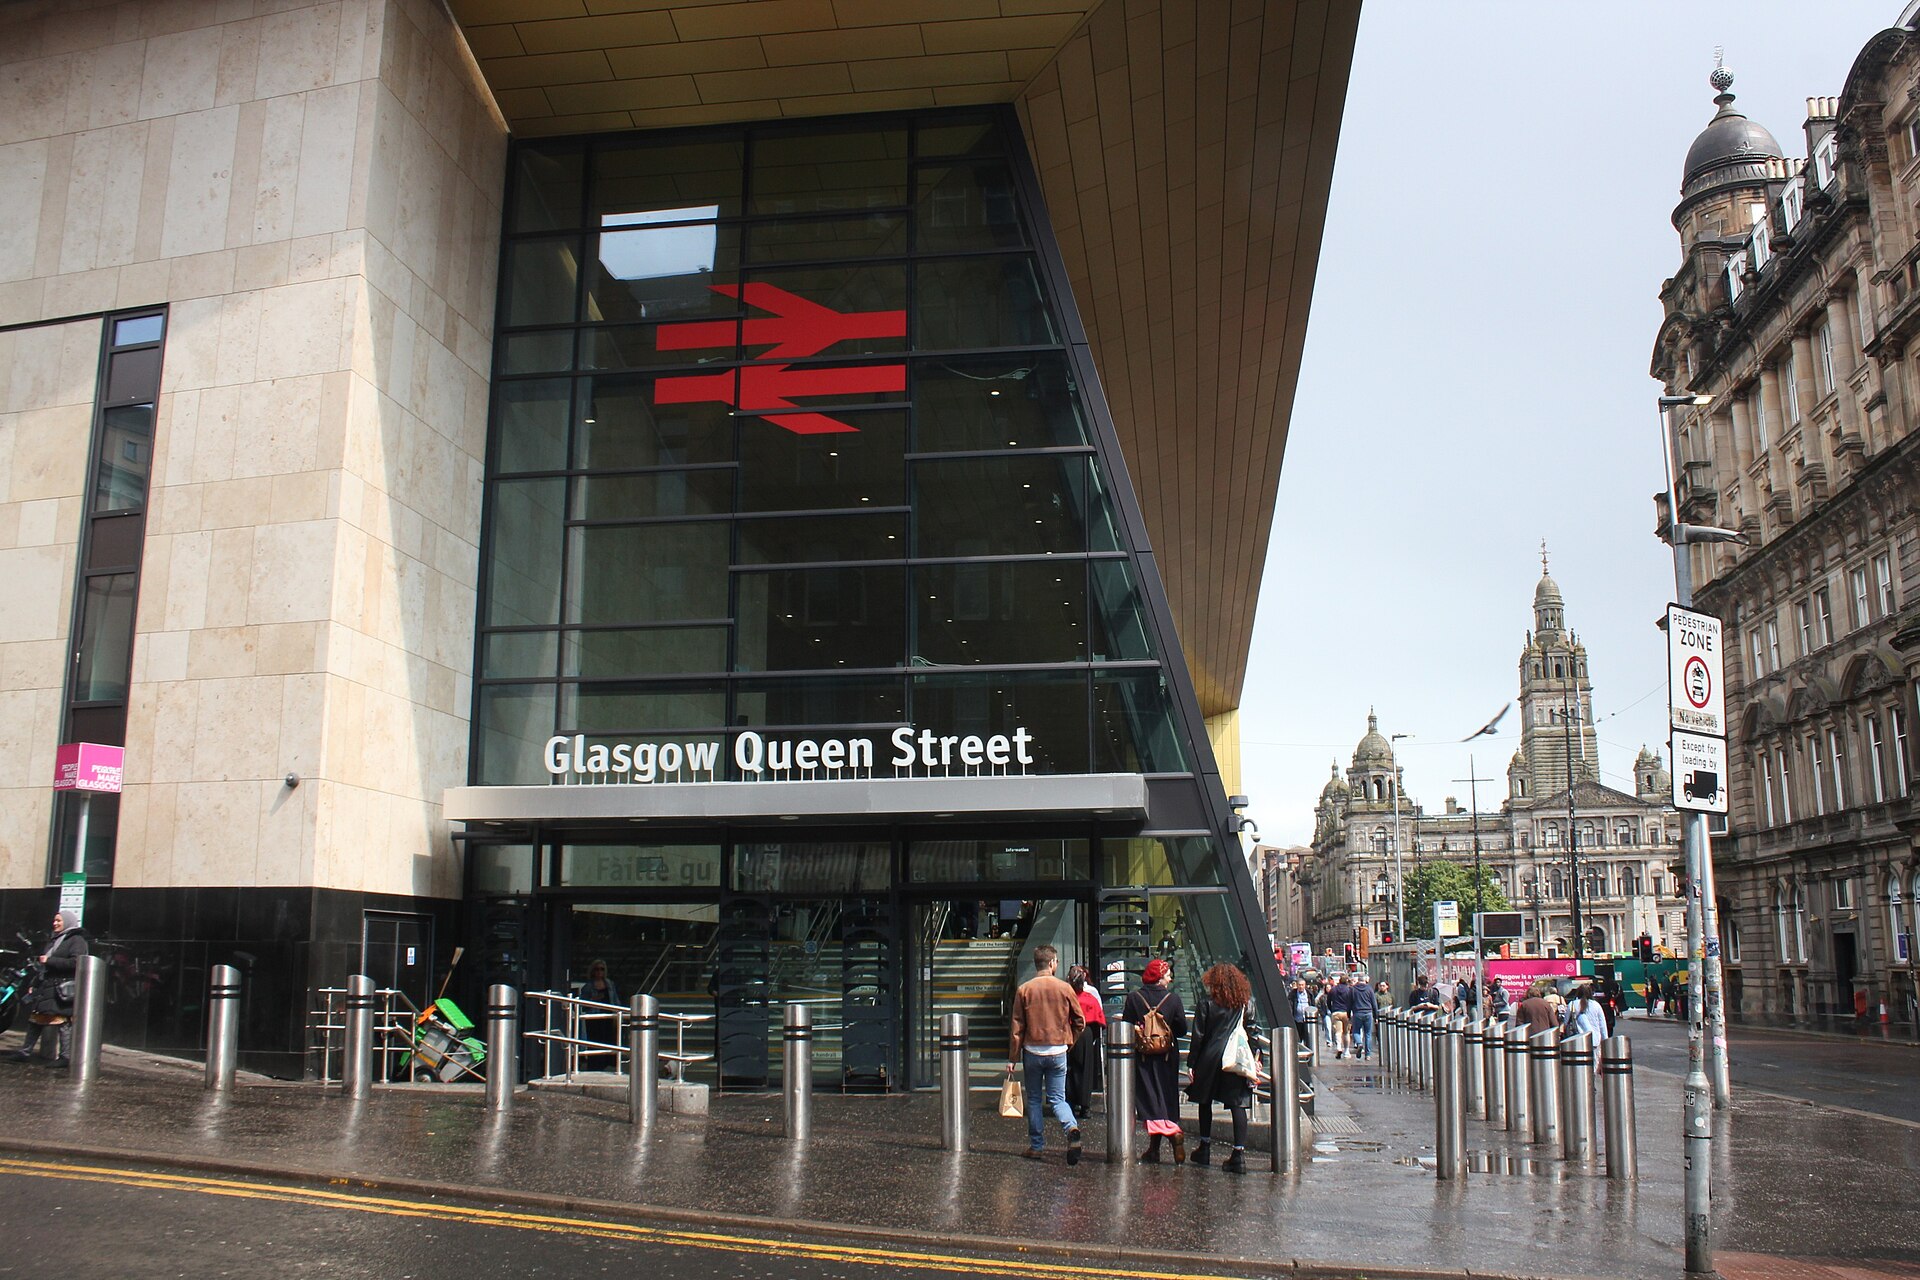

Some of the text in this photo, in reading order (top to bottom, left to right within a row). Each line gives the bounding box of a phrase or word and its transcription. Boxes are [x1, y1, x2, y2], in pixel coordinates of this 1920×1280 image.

[1673, 613, 1718, 635] PEDESTRIAN
[1680, 629, 1713, 652] ZONE
[1679, 710, 1689, 723] No
[1691, 713, 1718, 729] vehicles
[544, 726, 1034, 783] Glasgow Queen Street
[1682, 739, 1717, 755] Except for
[1682, 754, 1718, 771] loading by
[78, 779, 120, 790] GLASGOW
[97, 773, 121, 782] MAKE
[680, 862, 711, 887] gu
